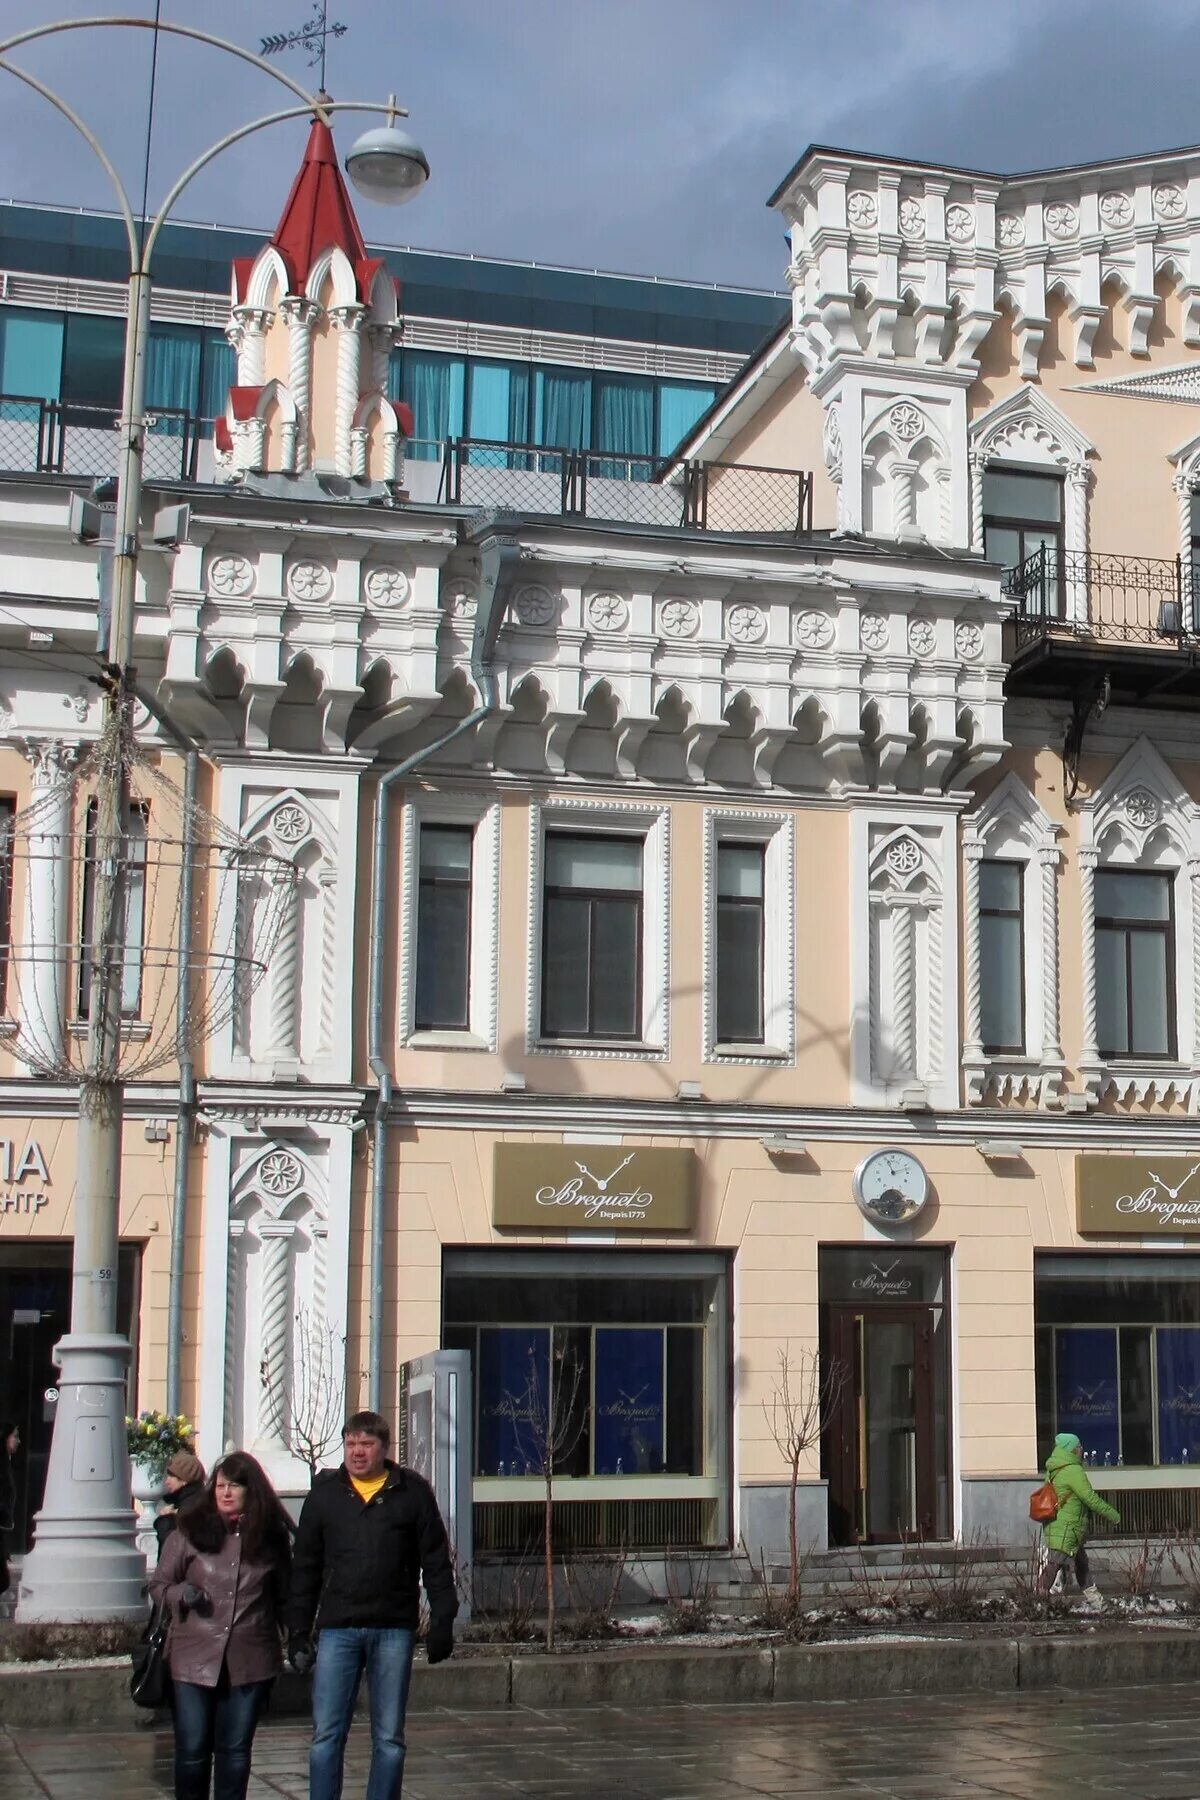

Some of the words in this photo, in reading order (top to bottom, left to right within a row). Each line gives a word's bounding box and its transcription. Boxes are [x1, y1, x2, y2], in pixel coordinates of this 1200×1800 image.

[0, 1192, 48, 1213] НТР
[536, 1178, 652, 1218] Breguet
[99, 1269, 112, 1279] 59
